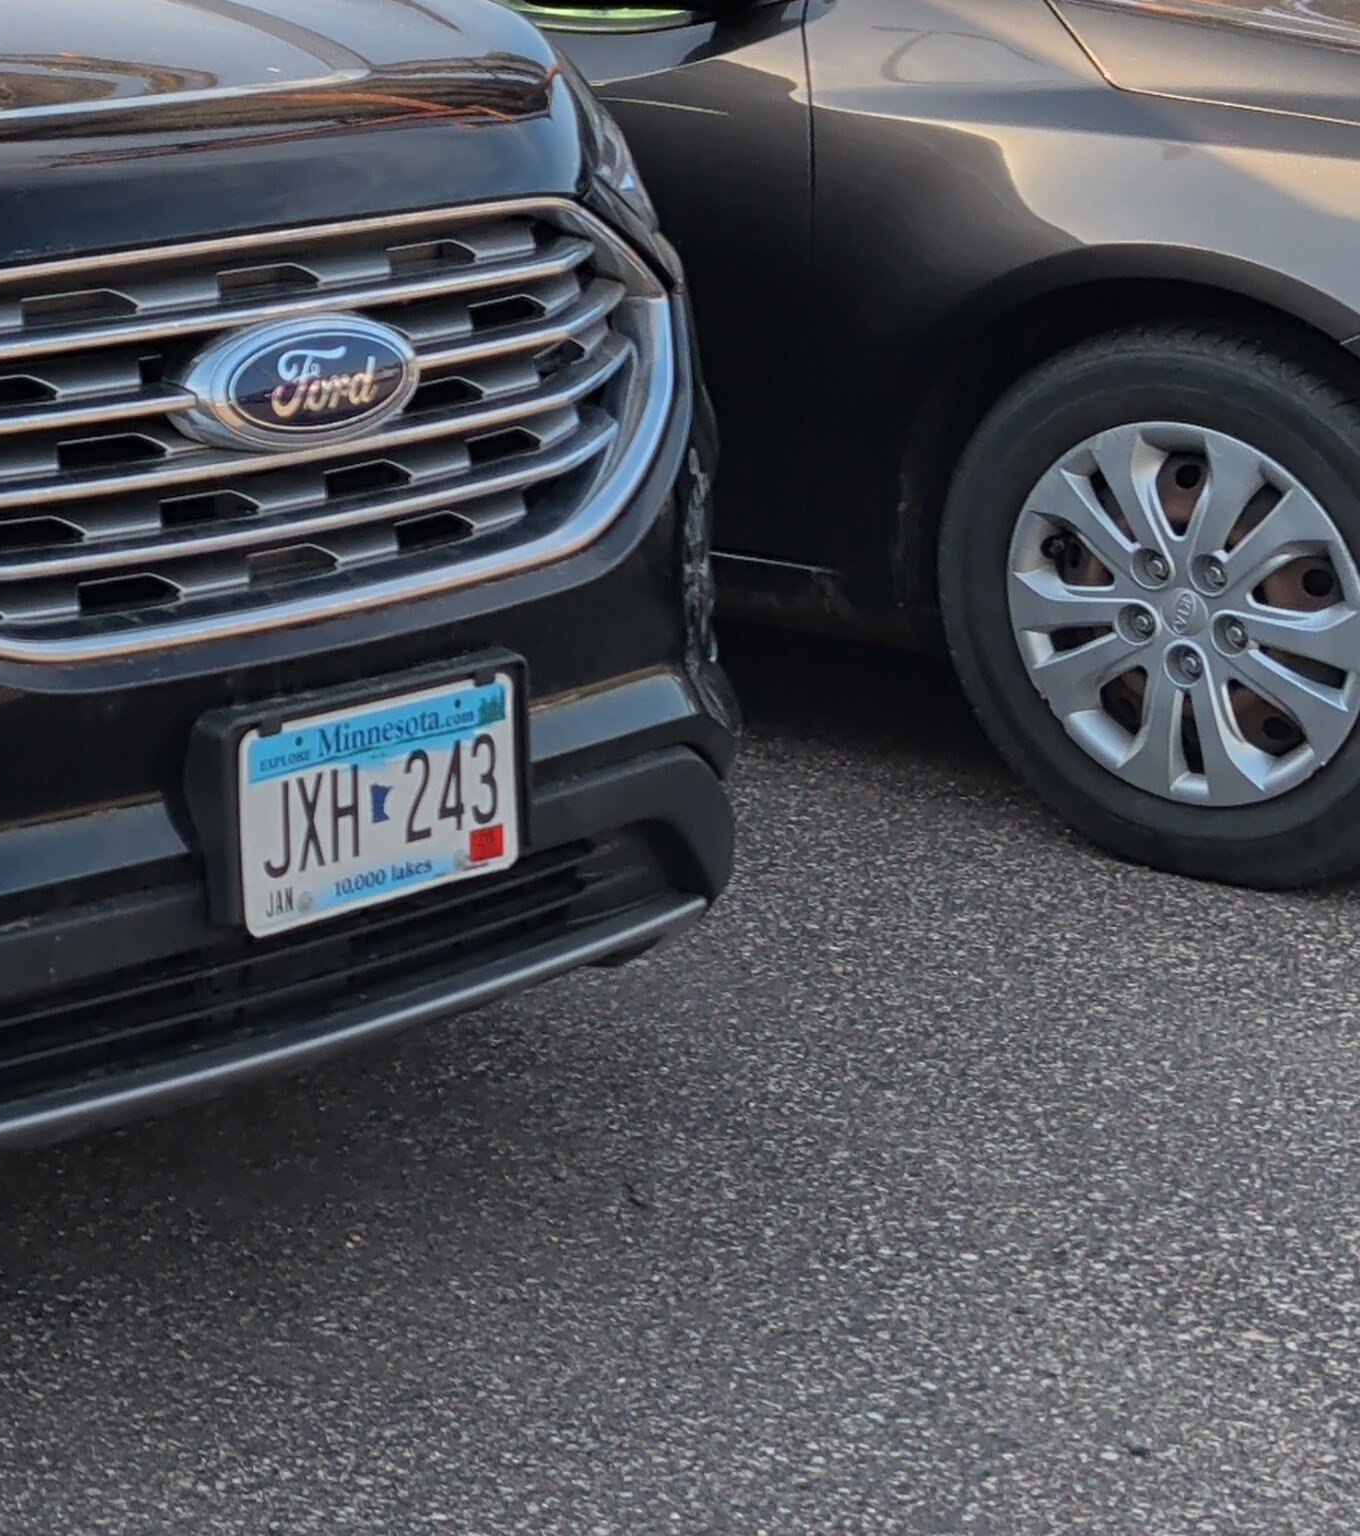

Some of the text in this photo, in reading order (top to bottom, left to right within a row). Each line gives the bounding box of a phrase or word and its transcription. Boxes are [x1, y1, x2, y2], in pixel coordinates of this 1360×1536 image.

[271, 345, 378, 418] Ford
[263, 733, 499, 879] JXH 243
[391, 858, 434, 882] lakes
[264, 885, 294, 919] JAN
